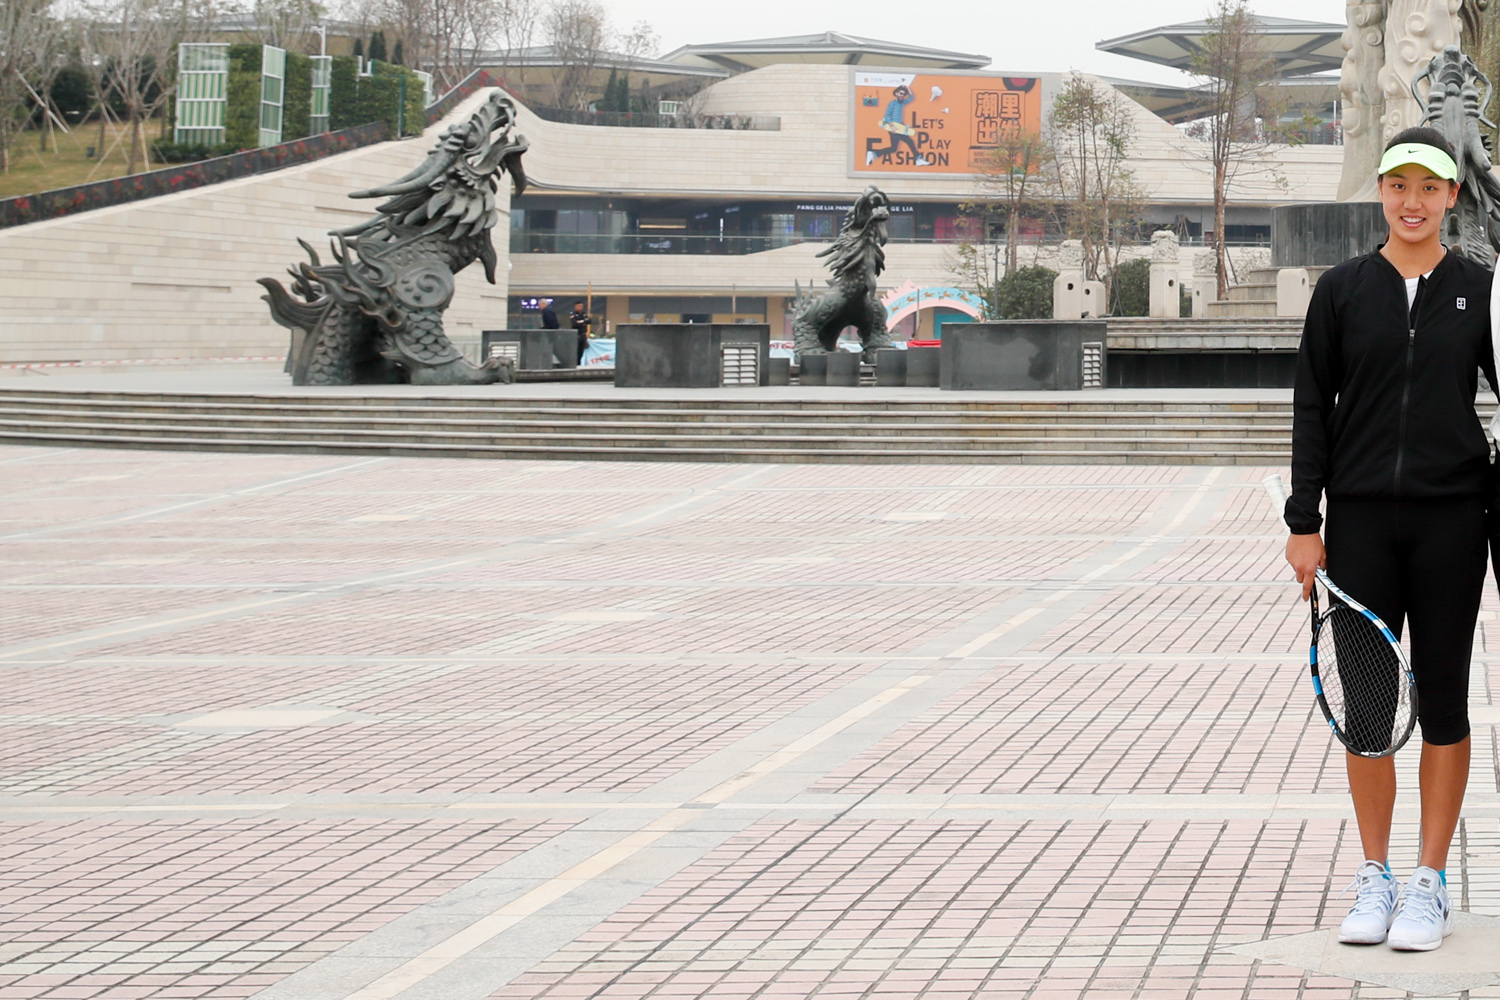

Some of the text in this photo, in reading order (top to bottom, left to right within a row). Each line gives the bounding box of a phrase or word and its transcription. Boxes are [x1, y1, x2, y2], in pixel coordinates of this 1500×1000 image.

[912, 111, 944, 129] LET'S
[917, 132, 951, 149] PLAY
[866, 138, 949, 166] FASHON
